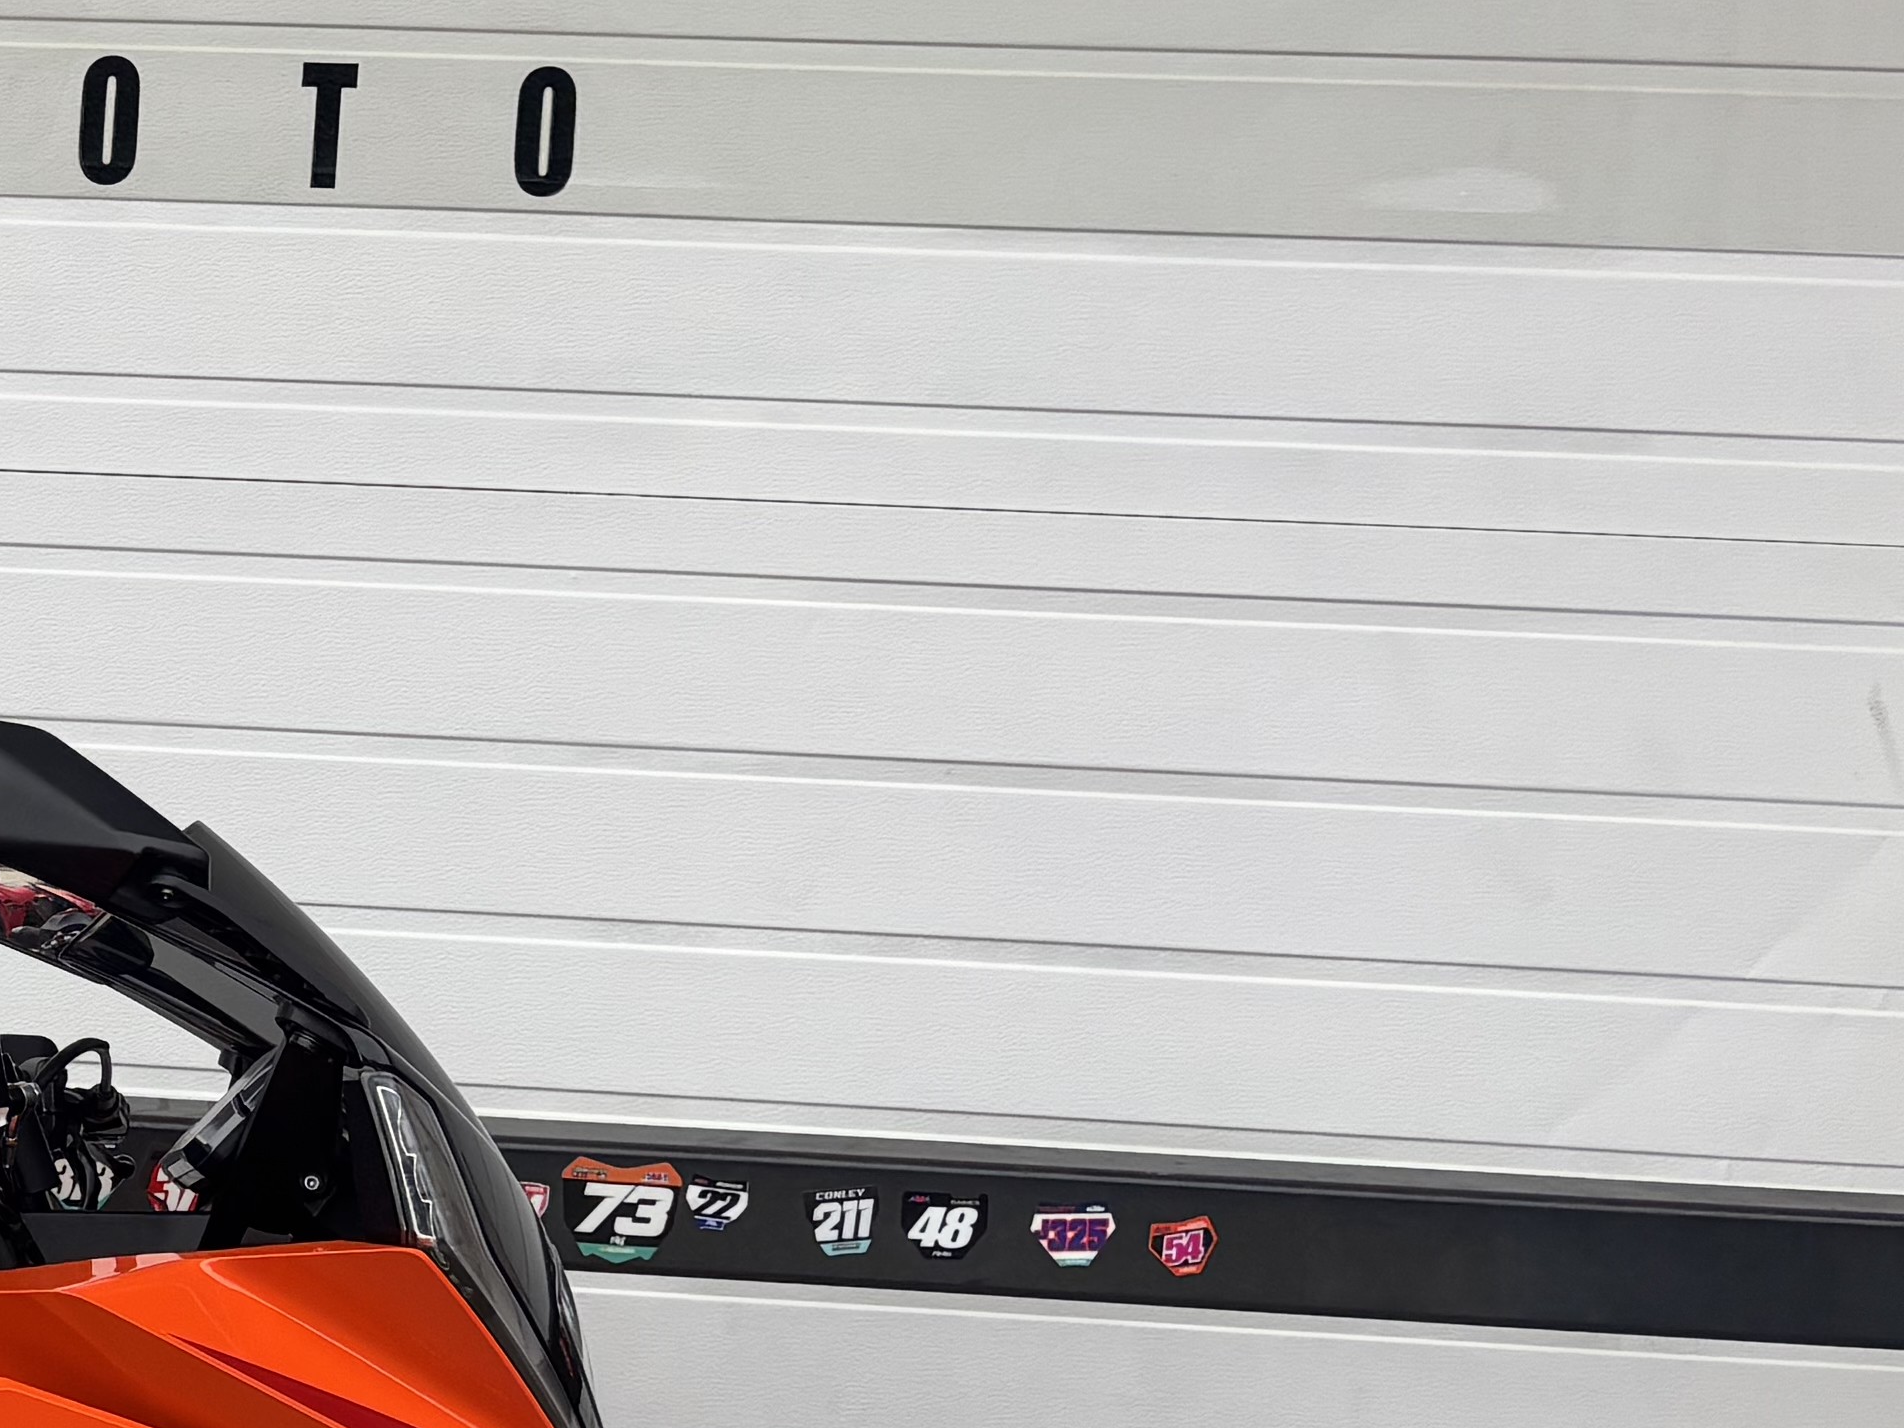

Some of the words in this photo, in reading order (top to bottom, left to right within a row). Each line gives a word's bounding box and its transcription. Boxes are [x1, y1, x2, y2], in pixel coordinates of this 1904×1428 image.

[573, 1182, 674, 1237] 73
[693, 1189, 741, 1220] 22
[815, 1188, 866, 1200] CONLEY
[812, 1198, 875, 1243] 211
[907, 1206, 979, 1249] 48
[1162, 1229, 1205, 1267] 54
